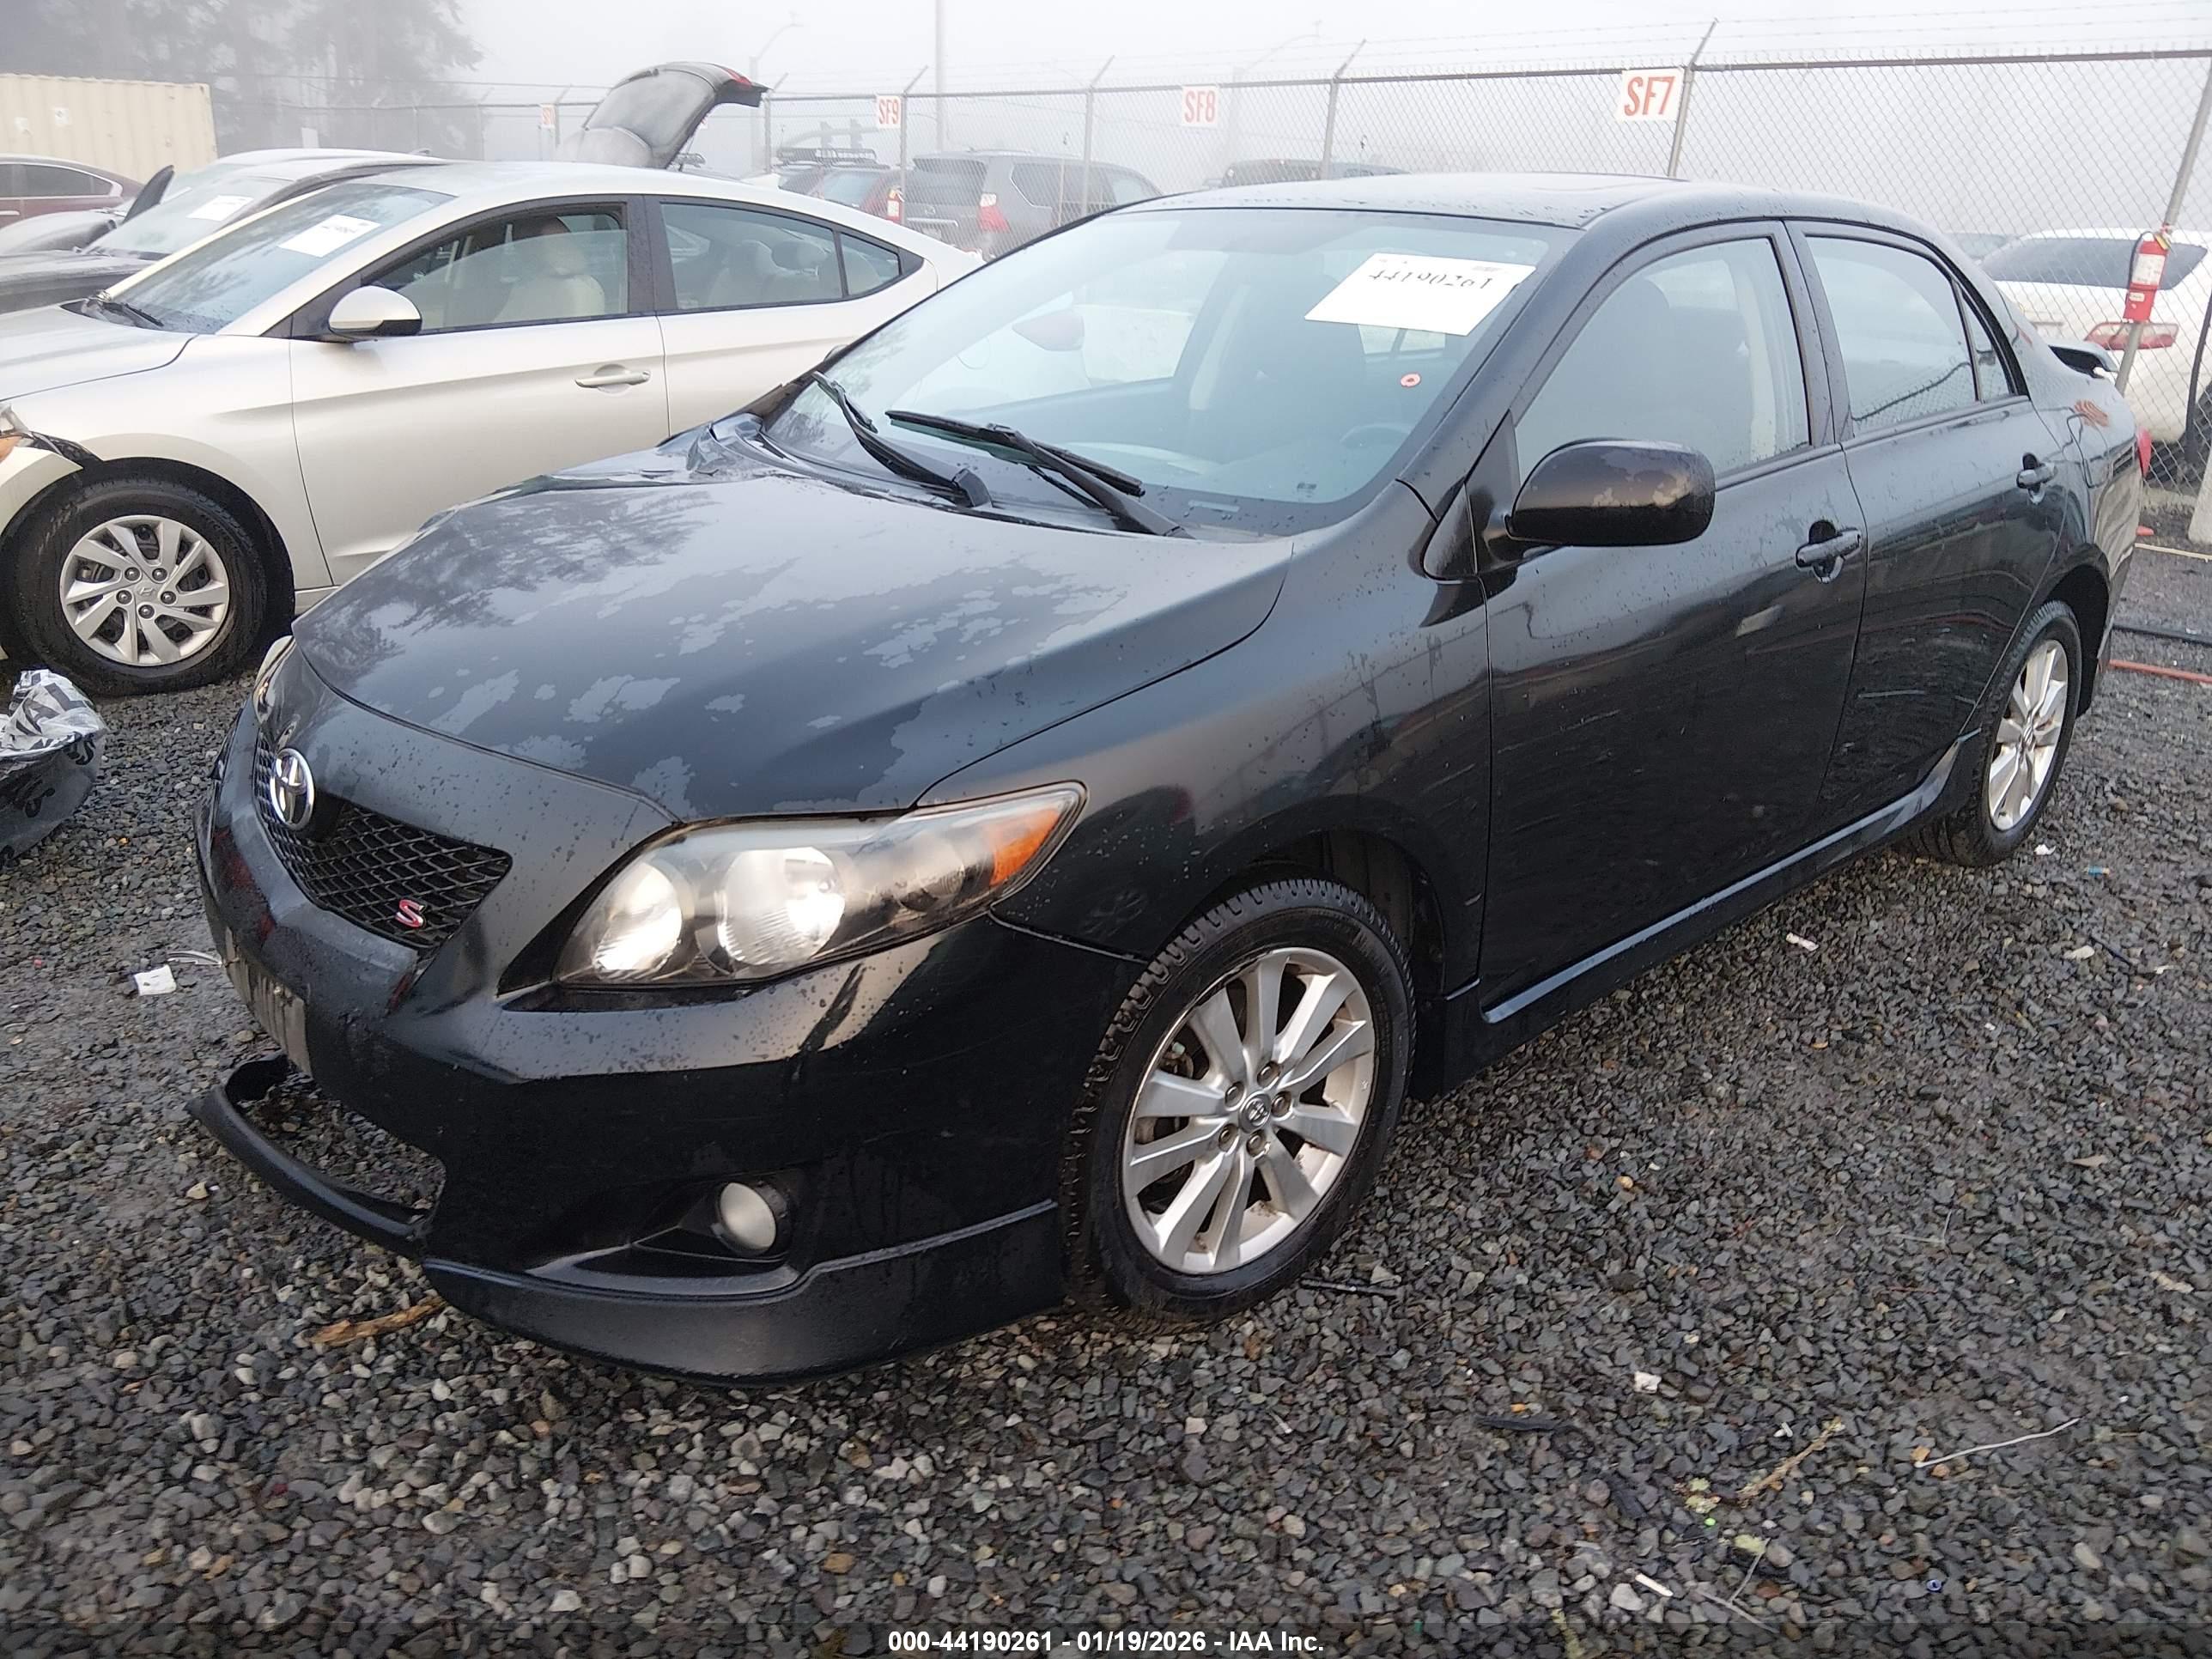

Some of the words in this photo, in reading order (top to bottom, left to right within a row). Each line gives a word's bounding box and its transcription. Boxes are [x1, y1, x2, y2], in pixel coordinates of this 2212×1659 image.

[878, 98, 900, 125] SF9
[1184, 90, 1216, 124] SF8
[1624, 76, 1676, 117] SF7
[395, 898, 426, 928] S
